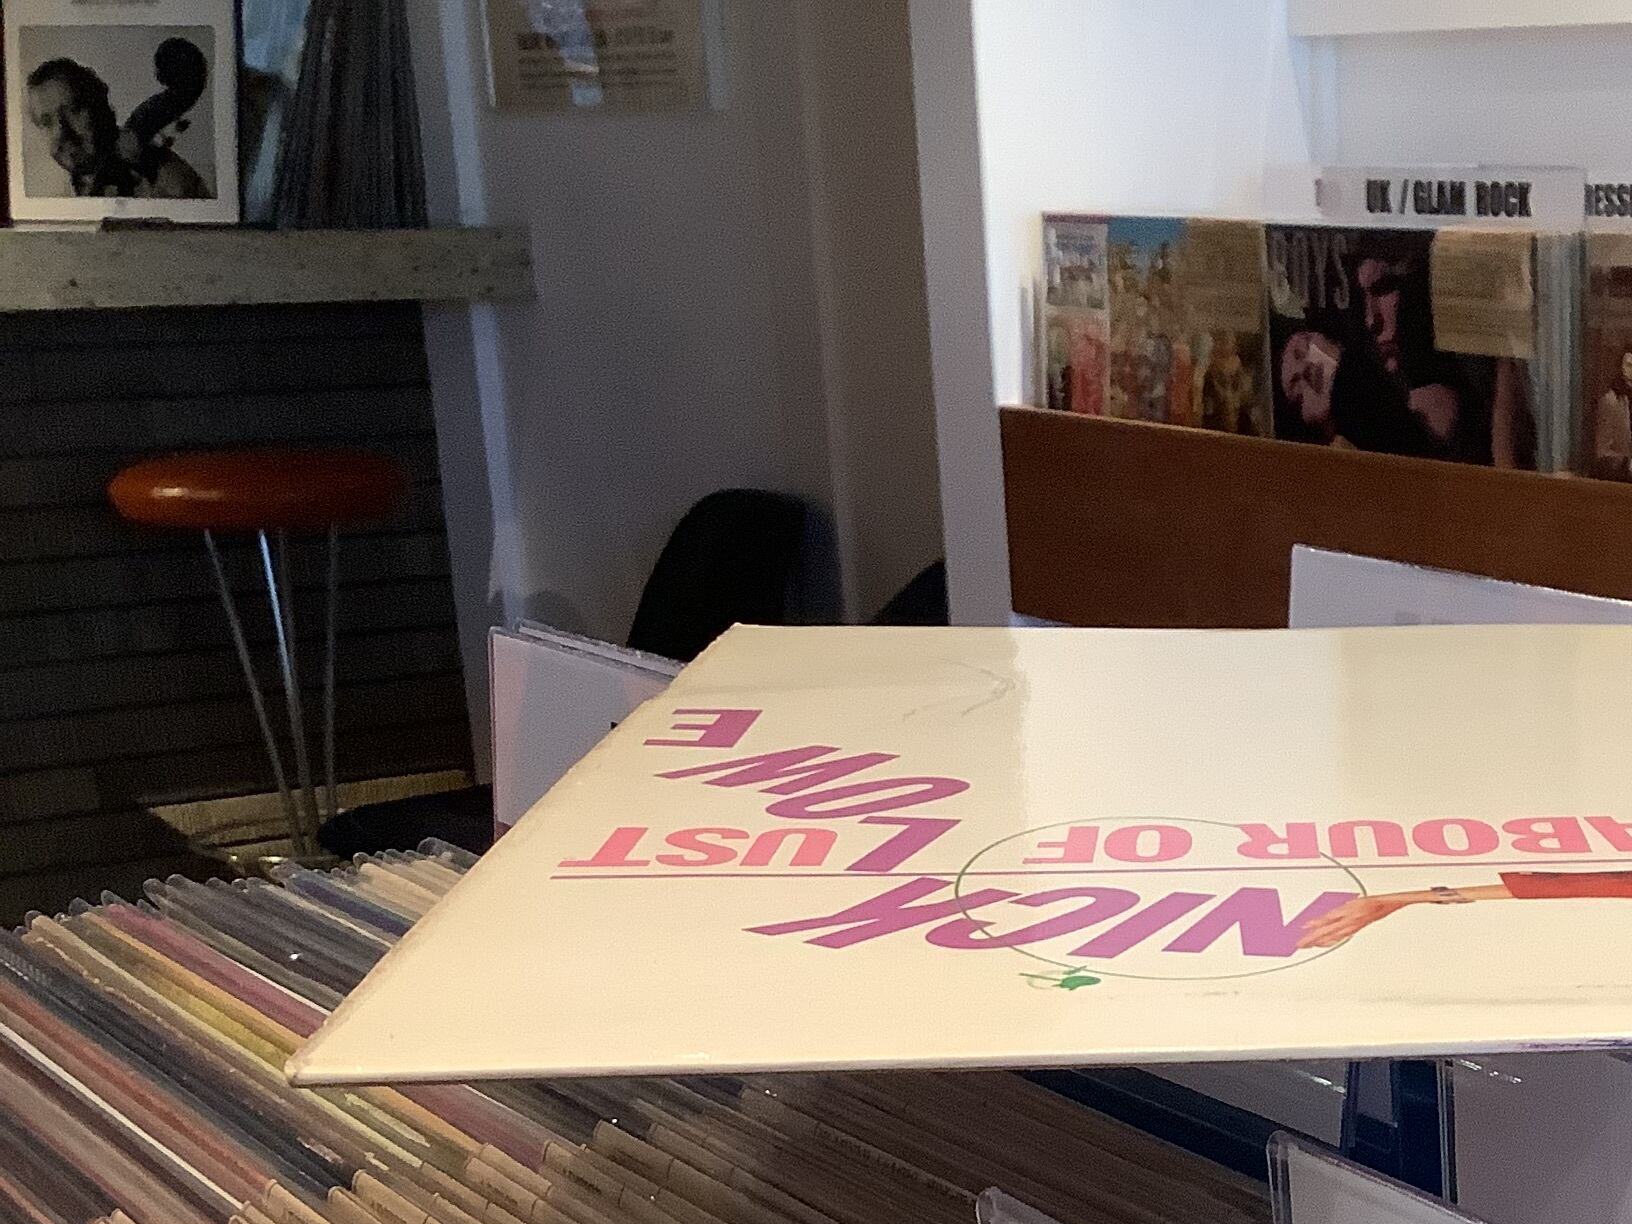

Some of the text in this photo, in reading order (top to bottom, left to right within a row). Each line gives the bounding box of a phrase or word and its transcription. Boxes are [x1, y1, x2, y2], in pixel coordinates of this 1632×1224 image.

[1366, 179, 1392, 213] UK
[1413, 179, 1466, 215] GLAM
[1475, 181, 1532, 217] ROCK
[643, 708, 1361, 959] NICK LOWE
[1023, 822, 1193, 866] OF
